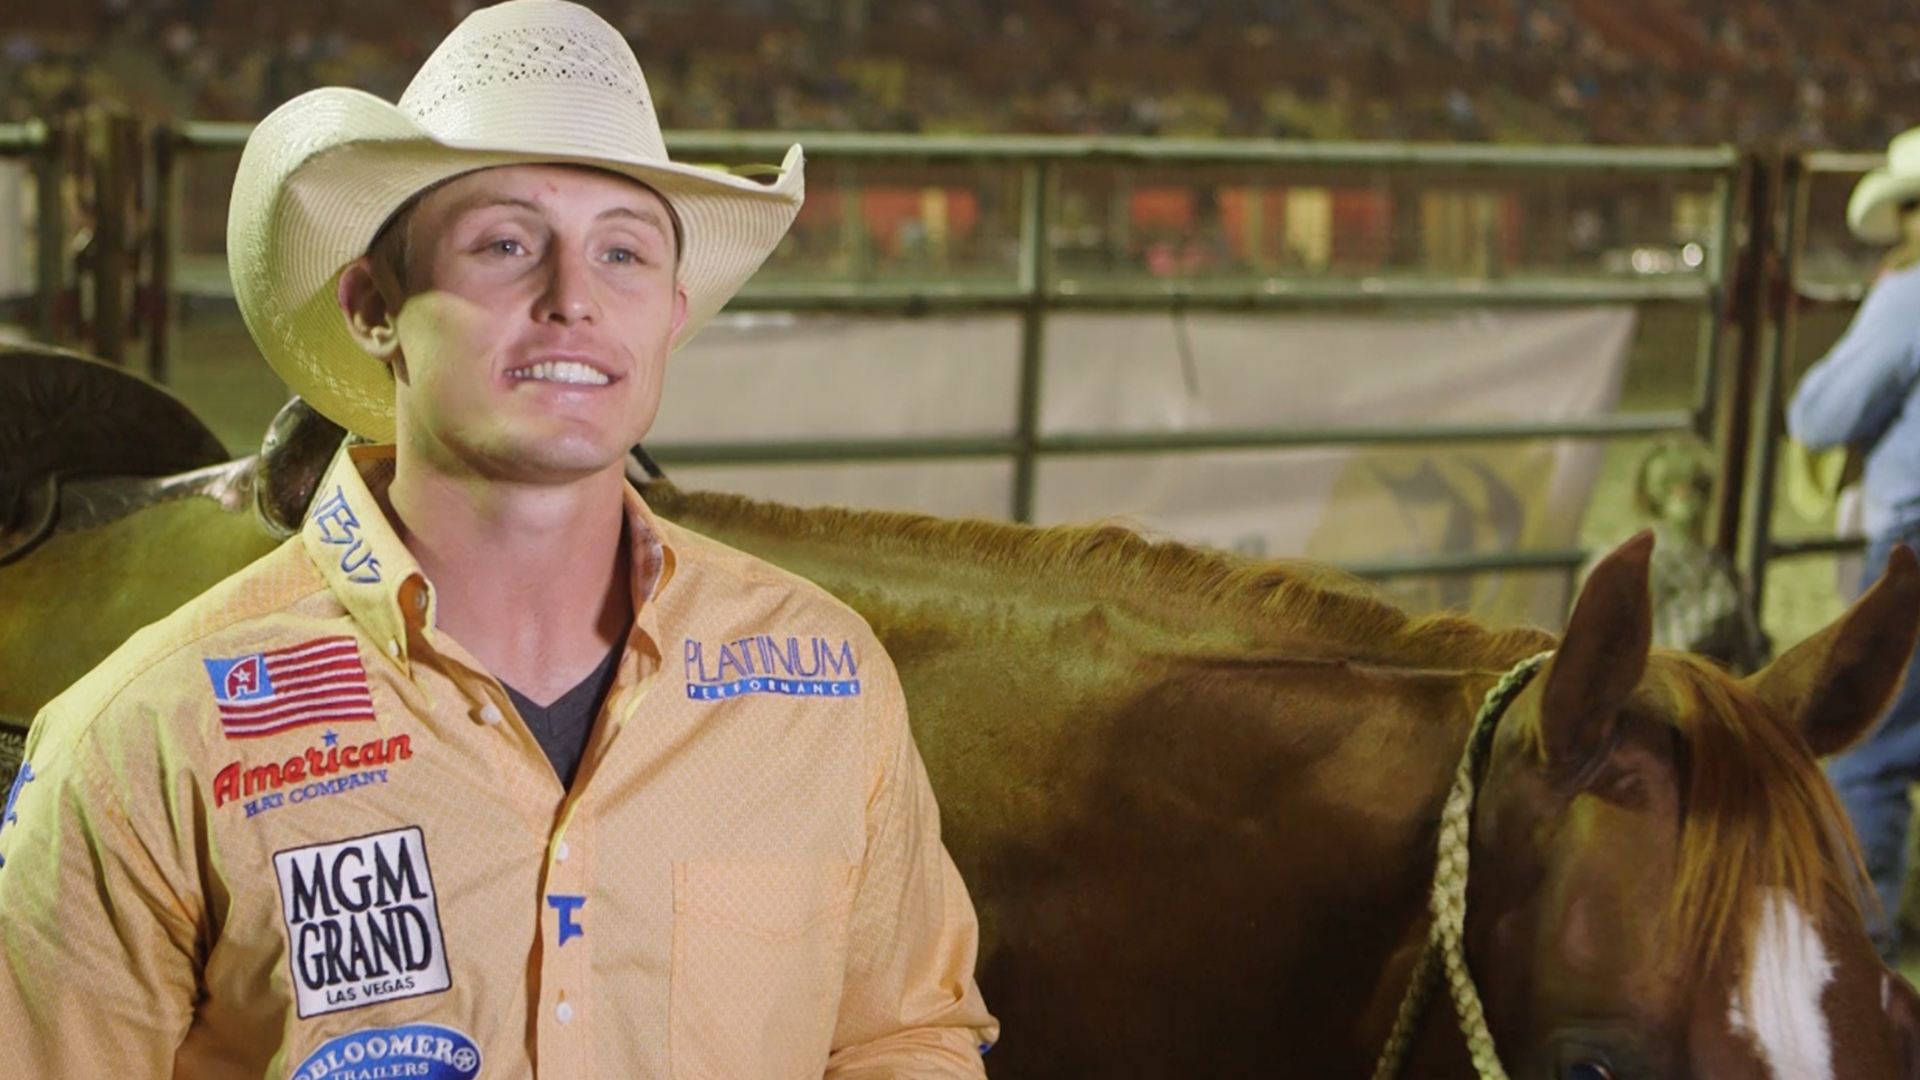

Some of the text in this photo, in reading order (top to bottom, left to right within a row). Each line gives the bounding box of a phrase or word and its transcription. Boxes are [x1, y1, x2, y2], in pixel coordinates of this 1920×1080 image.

[312, 484, 381, 584] JESUS
[684, 635, 857, 682] PLATINUM
[688, 679, 859, 700] PERFORMANCE
[213, 733, 414, 809] American
[244, 768, 389, 819] HAT COMPANY
[290, 836, 429, 925] MGM
[297, 904, 433, 991] GRAND
[326, 976, 416, 1006] LAS VEGAS
[307, 1034, 455, 1080] BLOOMER
[331, 1061, 430, 1080] TRAILERS
